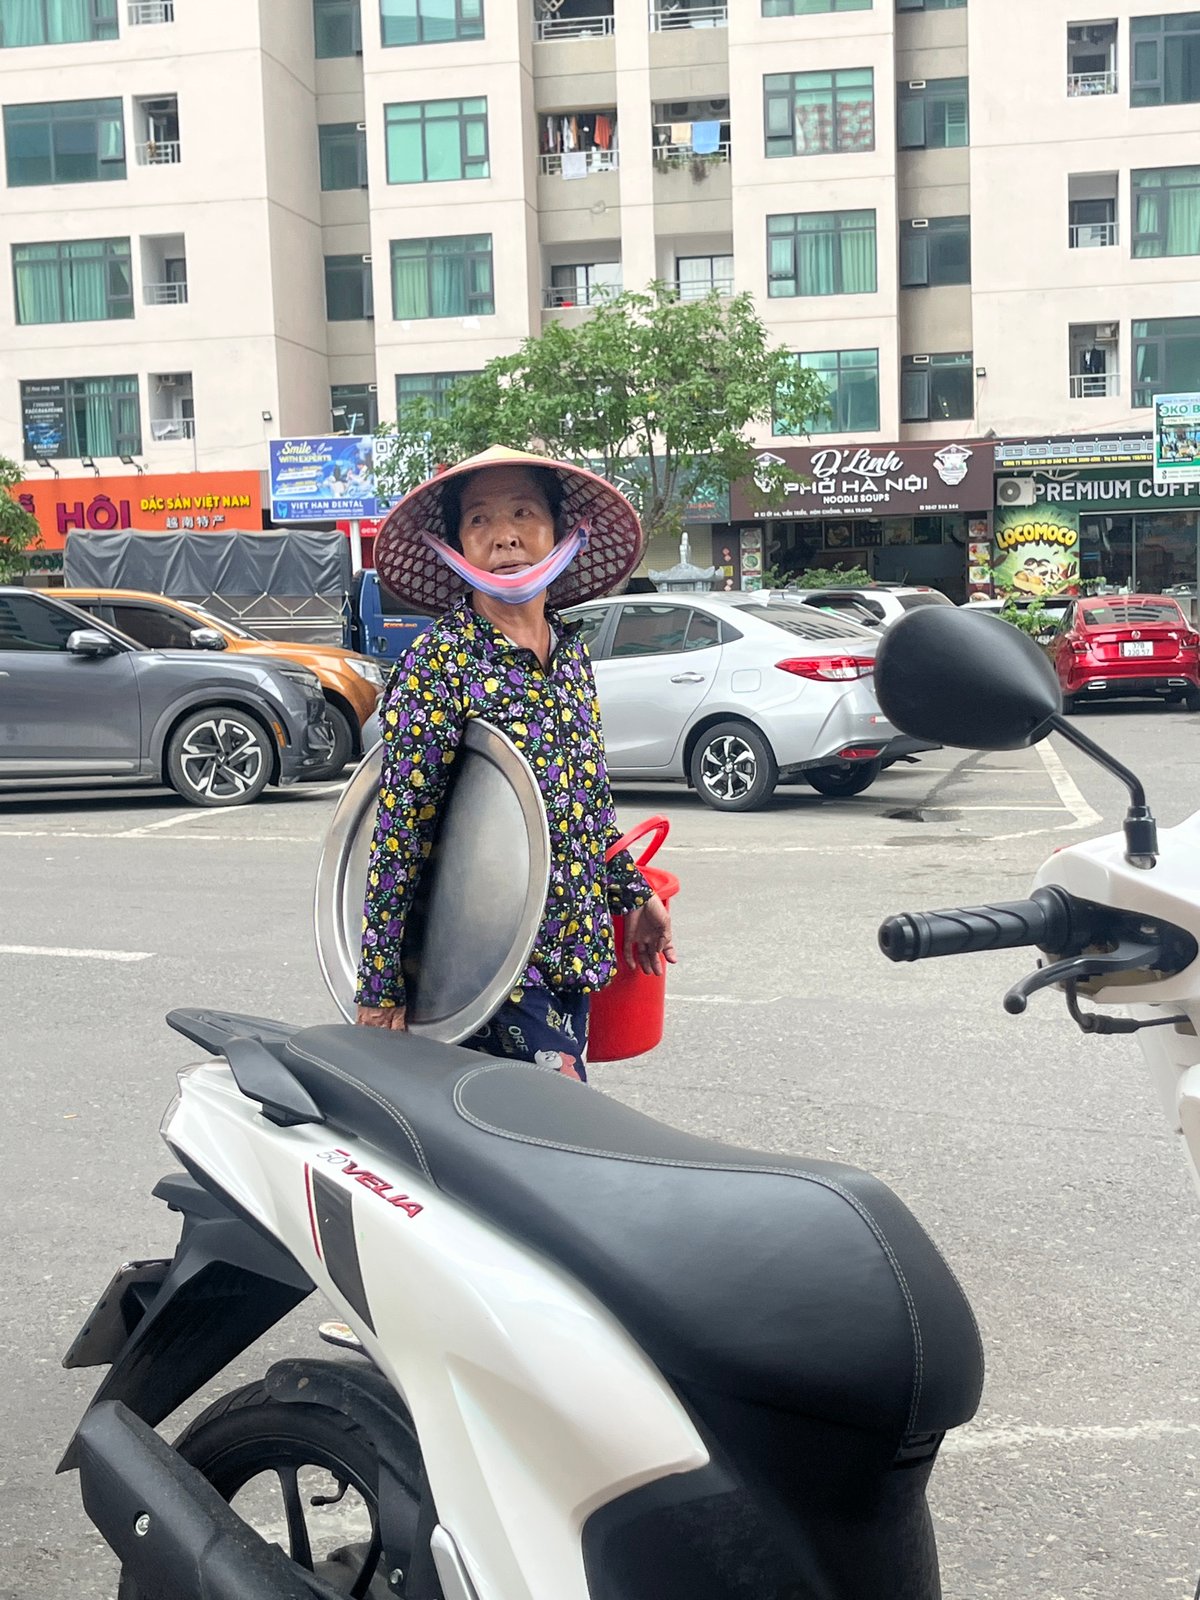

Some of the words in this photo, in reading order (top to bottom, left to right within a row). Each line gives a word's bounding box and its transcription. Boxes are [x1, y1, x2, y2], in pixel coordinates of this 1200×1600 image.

[281, 441, 312, 455] Smile
[810, 448, 903, 478] D'Linh
[842, 476, 878, 493] HÀ
[885, 474, 928, 493] NỘI
[1034, 480, 1131, 502] PREMIUM
[1138, 479, 1200, 498] COFF
[222, 495, 250, 507] NAM
[291, 502, 308, 510] VIET
[311, 501, 329, 509] HAN
[331, 500, 364, 509] DENTAL
[823, 495, 858, 505] NOODLE
[860, 493, 890, 503] SOUPS
[995, 522, 1078, 549] LOCOMOCO
[341, 1160, 424, 1218] VELIA
